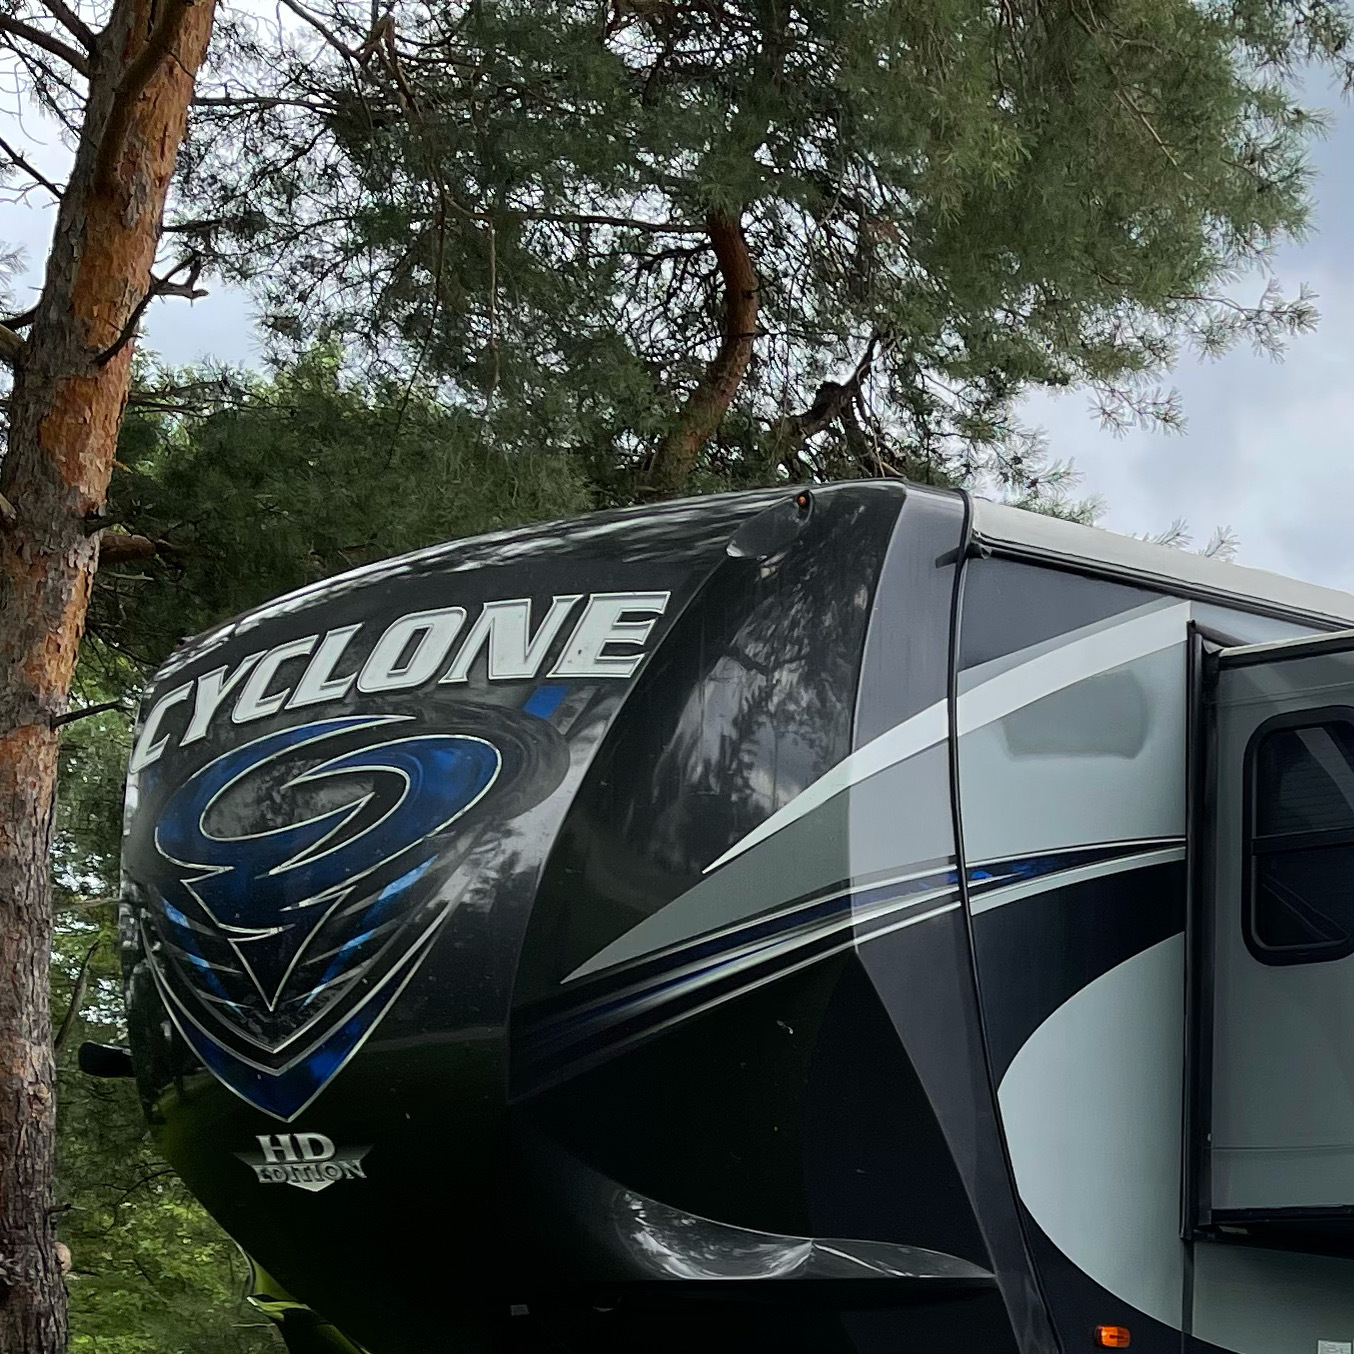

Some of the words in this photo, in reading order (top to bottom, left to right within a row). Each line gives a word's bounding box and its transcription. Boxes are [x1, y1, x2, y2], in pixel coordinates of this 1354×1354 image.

[129, 590, 672, 774] CYCLONE
[255, 1132, 336, 1163] HD
[252, 1160, 368, 1183] EDITION
